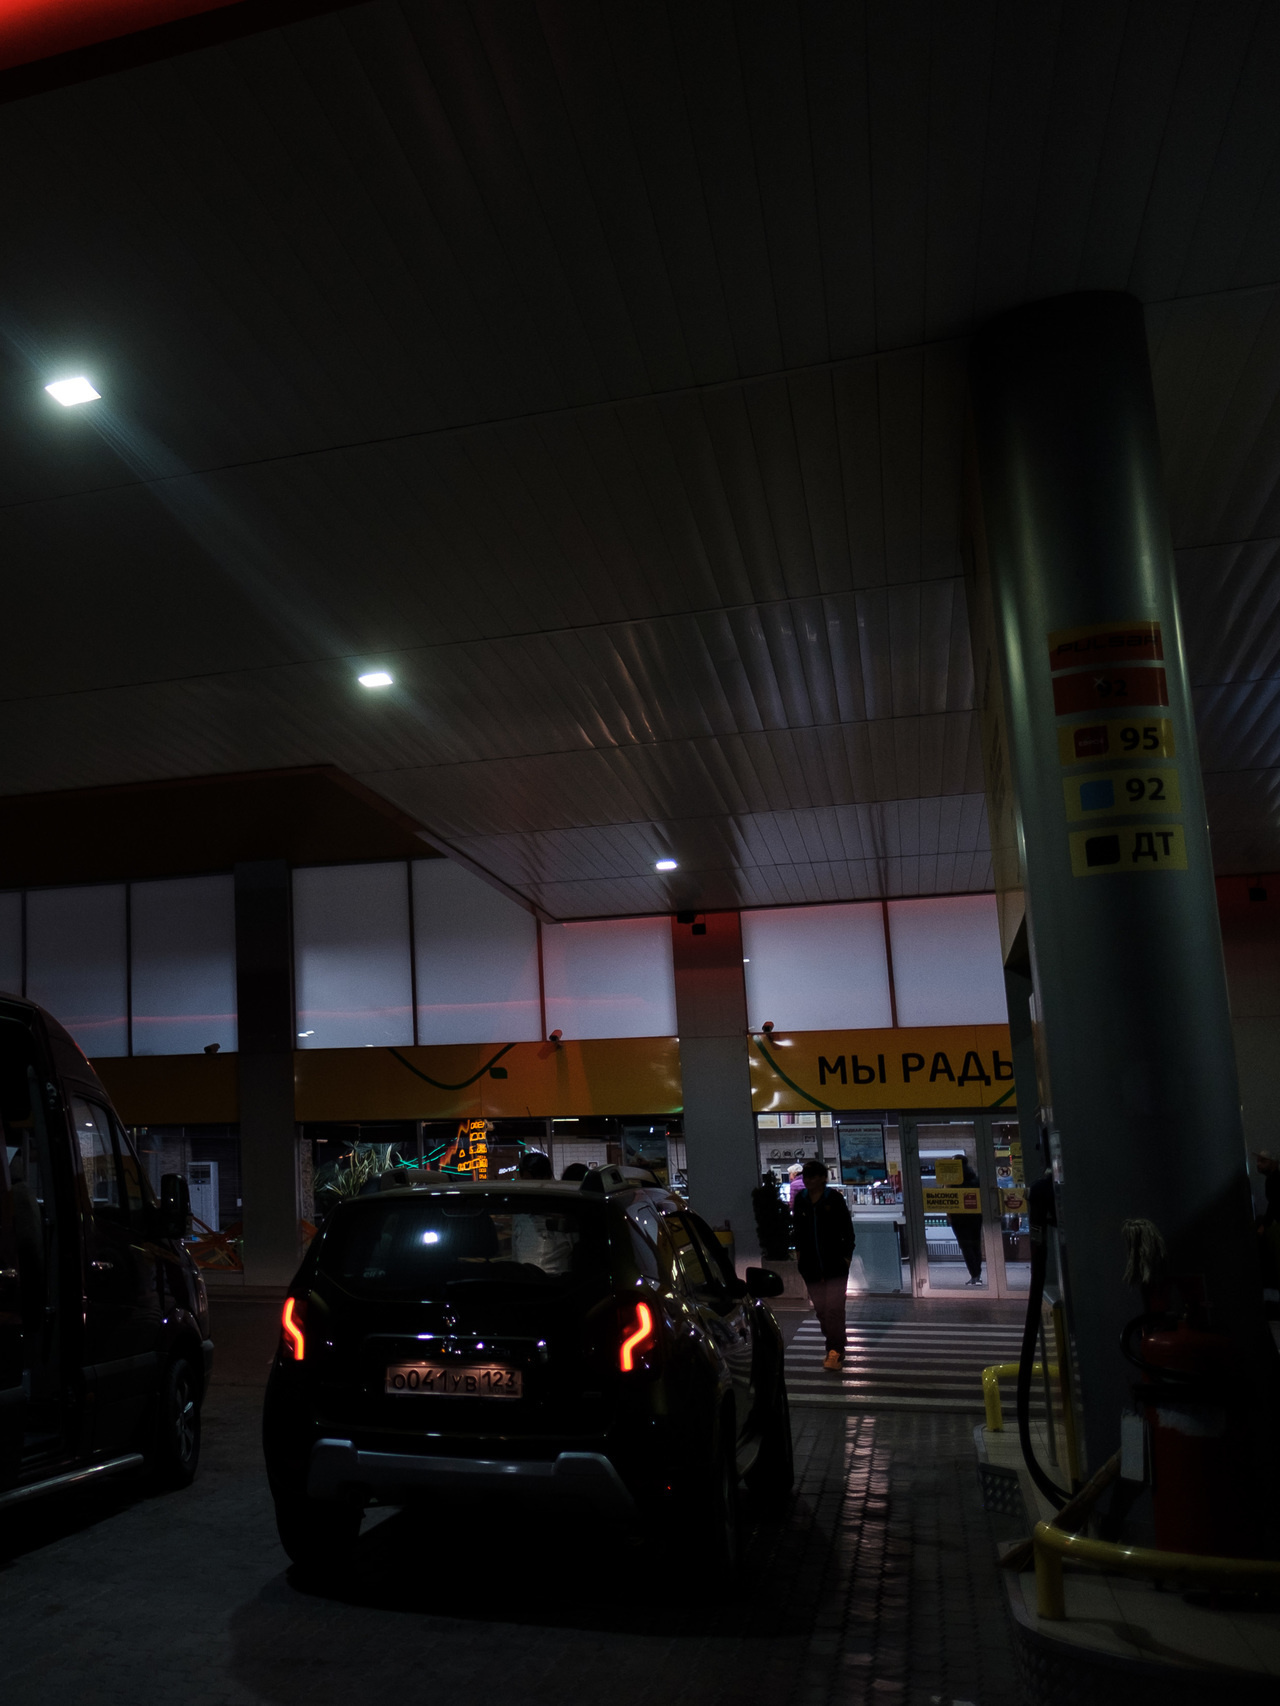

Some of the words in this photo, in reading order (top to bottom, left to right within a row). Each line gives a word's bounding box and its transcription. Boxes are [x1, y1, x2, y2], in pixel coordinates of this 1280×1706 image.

[1097, 679, 1128, 697] 92
[1120, 726, 1159, 750] 95
[1126, 777, 1166, 801] 92
[1132, 832, 1174, 862] ДТ
[818, 1054, 886, 1085] МЫ
[482, 1371, 515, 1387] 123
